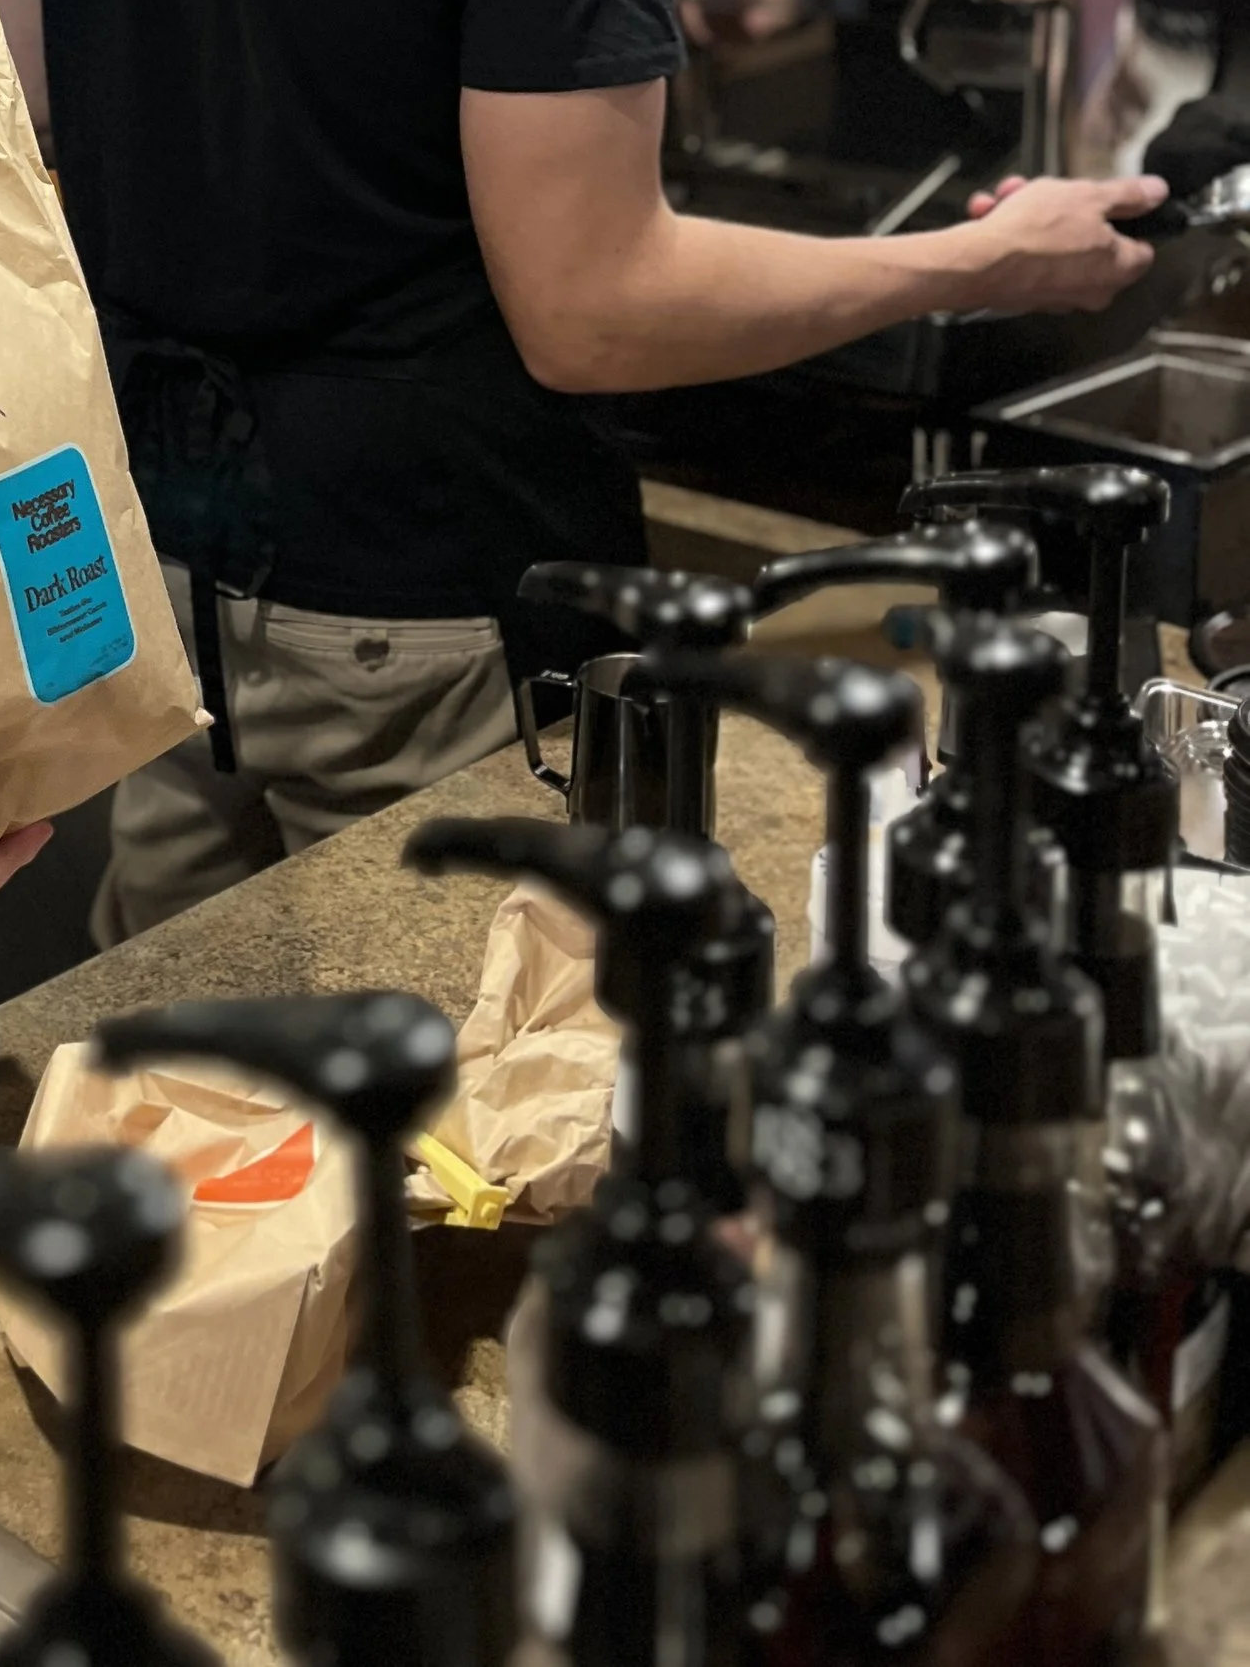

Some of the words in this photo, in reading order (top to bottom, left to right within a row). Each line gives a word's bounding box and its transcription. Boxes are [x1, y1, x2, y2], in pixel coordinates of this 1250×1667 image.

[11, 478, 75, 522] Necessary
[30, 500, 71, 532] Coffee
[23, 572, 69, 614] Dark
[65, 554, 109, 592] Roast
